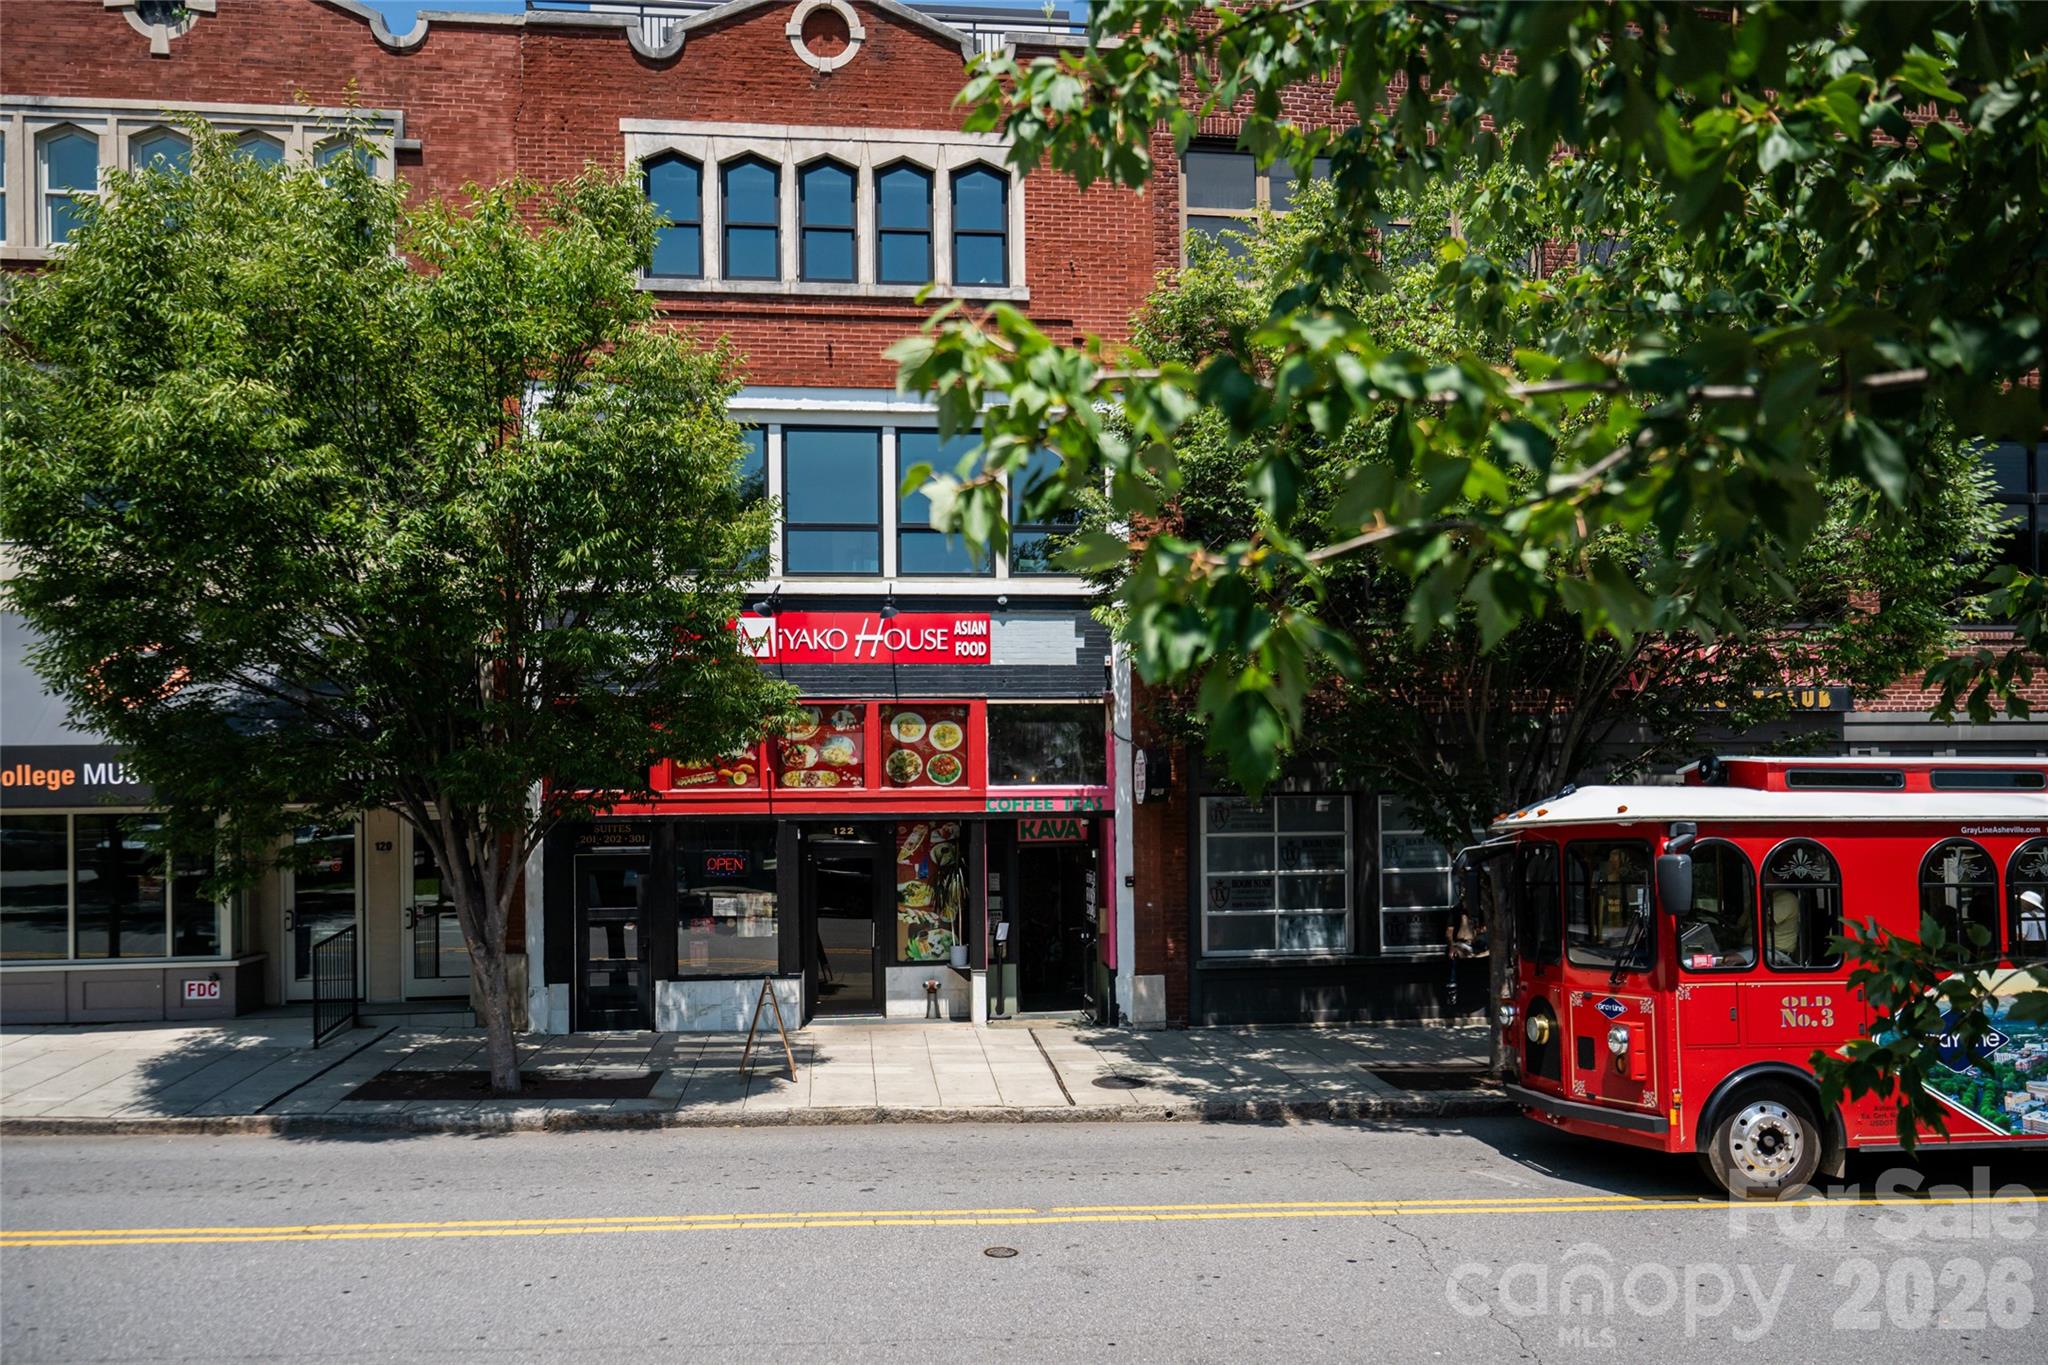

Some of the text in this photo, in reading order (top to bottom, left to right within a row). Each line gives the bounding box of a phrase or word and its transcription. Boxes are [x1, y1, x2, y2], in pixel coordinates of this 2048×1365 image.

[954, 621, 987, 635] ASIAN
[855, 618, 948, 657] HOUSE
[955, 642, 987, 656] FOOD
[0, 764, 75, 791] ollege
[986, 796, 1102, 812] COFFEE TEAS
[593, 824, 632, 833] SUITES
[833, 827, 854, 835] 122
[1020, 819, 1081, 839] KAVA
[706, 857, 744, 871] OPEN
[187, 982, 217, 997] FDC
[1781, 996, 1832, 1007] OLD
[1780, 1008, 1834, 1027] No. 3
